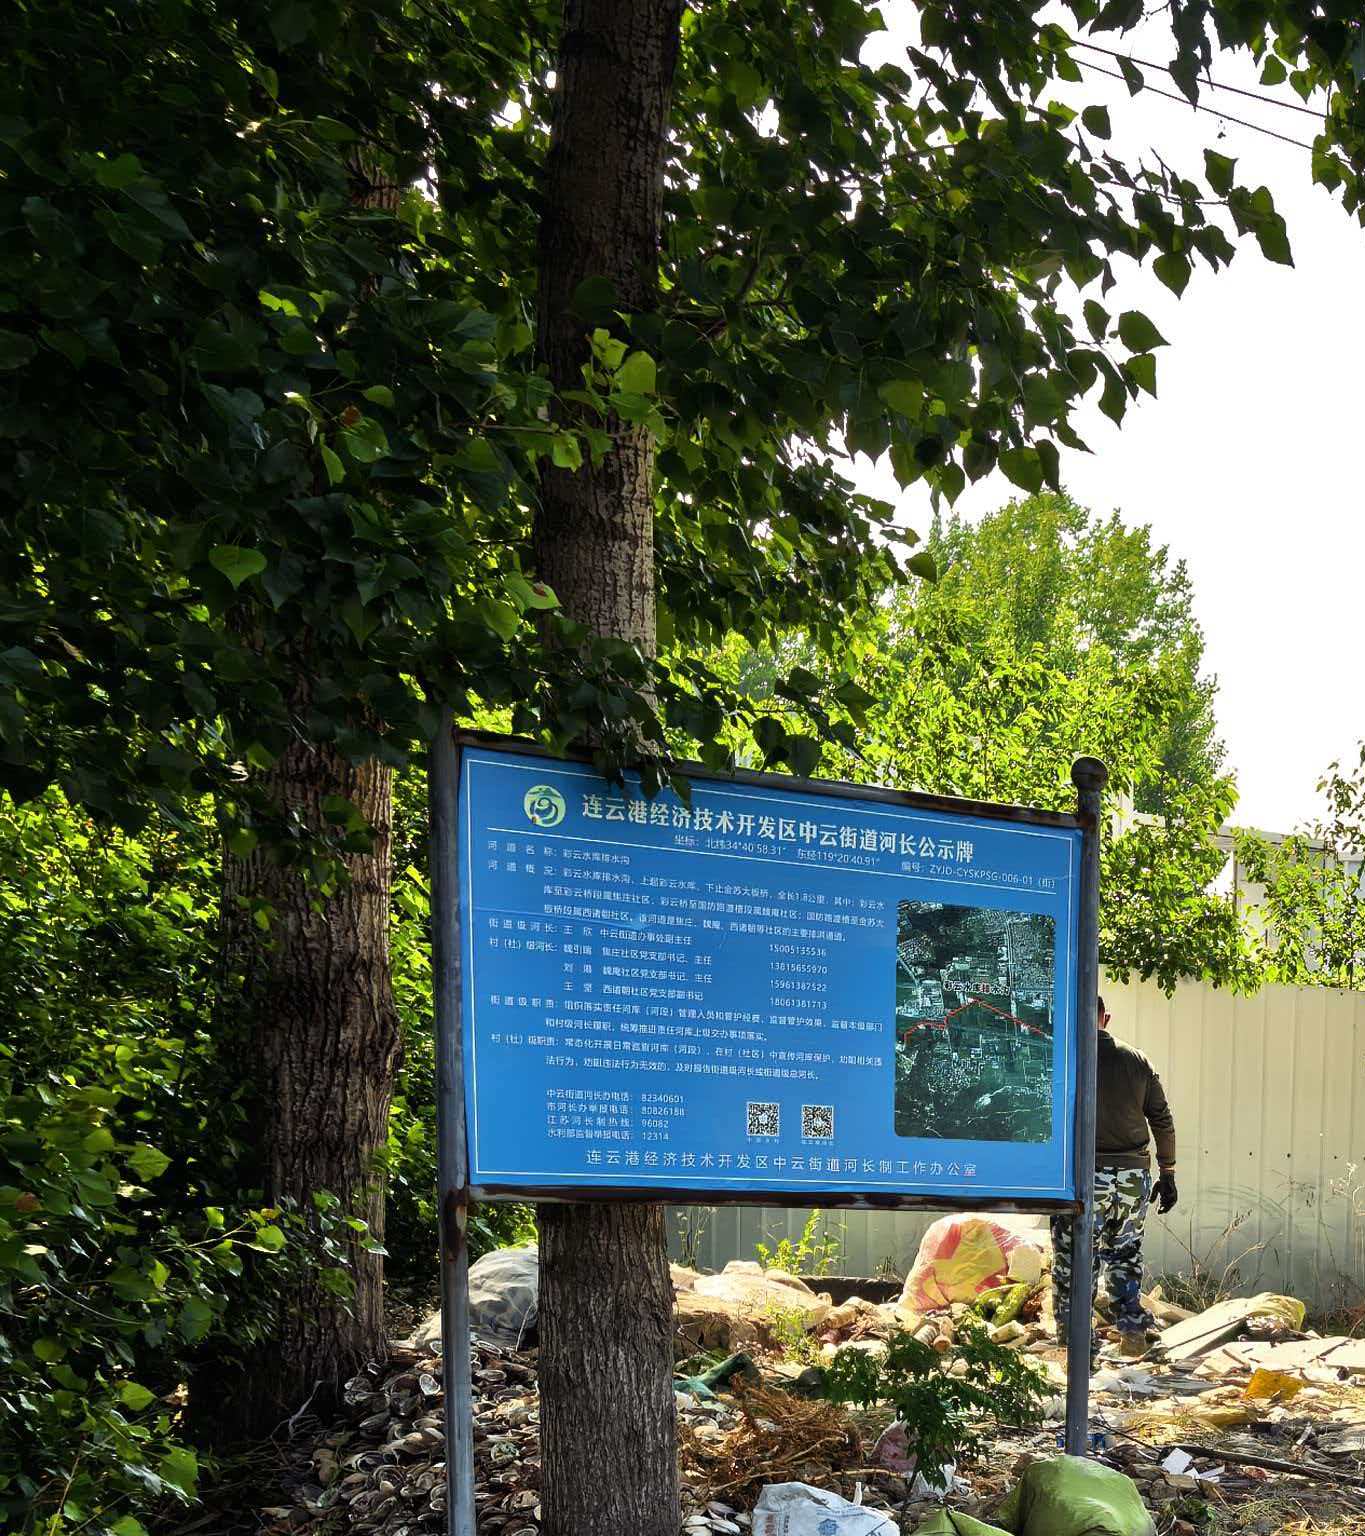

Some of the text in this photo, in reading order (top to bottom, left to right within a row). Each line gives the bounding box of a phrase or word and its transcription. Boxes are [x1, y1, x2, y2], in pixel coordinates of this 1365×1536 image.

[582, 793, 974, 863] 连云港经济技术开发区中云街道河长公示牌
[586, 1149, 977, 1178] 连云港经济技术开发区中云街道河长制工作办公室
